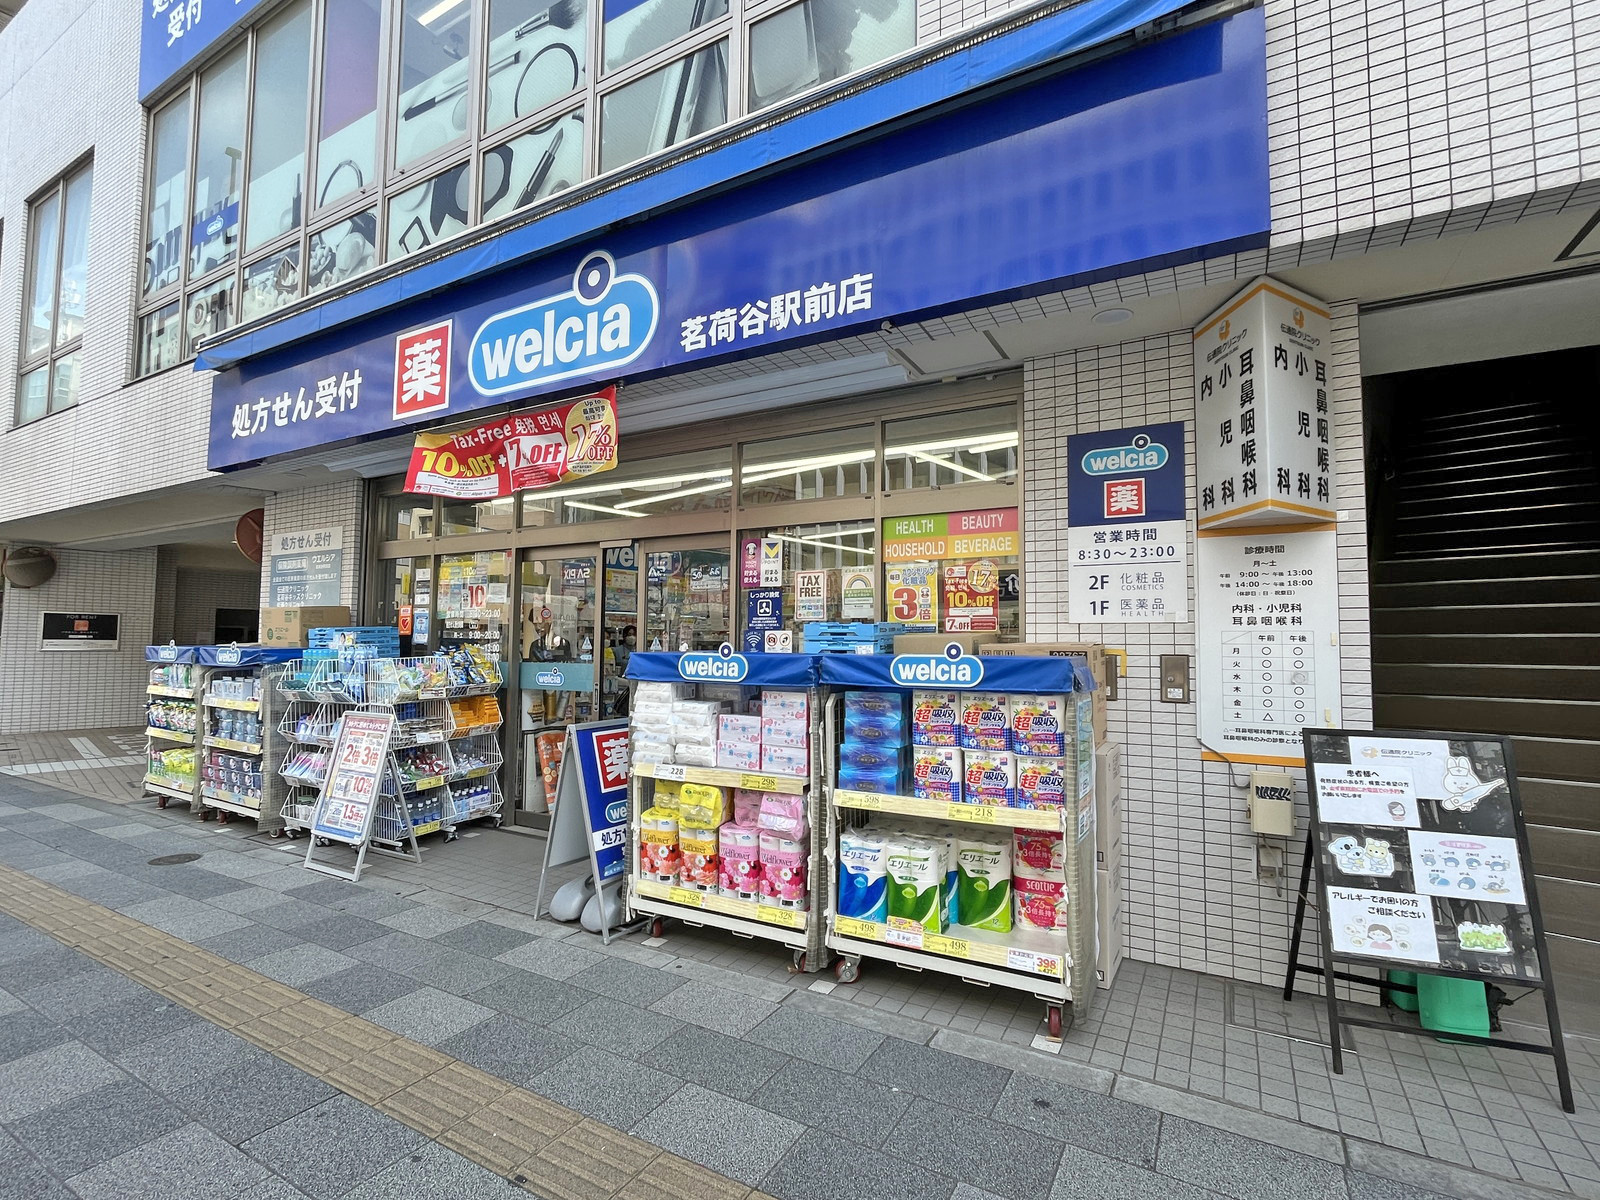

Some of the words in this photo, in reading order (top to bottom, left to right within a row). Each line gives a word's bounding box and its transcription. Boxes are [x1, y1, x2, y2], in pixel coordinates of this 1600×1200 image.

[167, 0, 203, 48] 受付
[679, 272, 874, 353] 茗荷谷駅前店
[481, 302, 630, 381] welcia
[401, 338, 443, 403] 薬
[231, 369, 363, 440] 処方せん受付
[1239, 347, 1258, 498] 耳鼻咽喉科
[451, 424, 512, 449] Tax-Free
[1314, 358, 1330, 503] 耳鼻咽喉科
[587, 445, 615, 461] OFF
[1090, 450, 1159, 471] welcia
[1109, 484, 1139, 513] 薬
[895, 519, 934, 535] HEALTH
[961, 513, 1004, 530] BEAUTY
[281, 532, 332, 551] 処方せん受付
[1093, 528, 1157, 544] 営業時間
[885, 541, 945, 558] HOUSEHOLD
[954, 536, 1012, 553] BEVERAGE
[1244, 545, 1285, 555] 診療時間
[1287, 569, 1313, 577] 13:00
[800, 575, 821, 587] TAX
[1089, 574, 1109, 590] 2F
[1120, 571, 1165, 584] 化粧品
[1287, 579, 1313, 587] 18:00
[799, 587, 822, 598] FREE
[1121, 583, 1164, 591] COSMETICS
[1089, 600, 1109, 616] 1F
[1120, 597, 1165, 610] 医薬品
[1232, 616, 1303, 626] 耳鼻咽喉科
[1258, 634, 1275, 642] 午前
[1289, 634, 1307, 643] 午後
[1232, 647, 1240, 655] 月
[684, 657, 740, 678] welcia
[1232, 660, 1241, 668] 火
[897, 660, 971, 681] welcia
[538, 674, 561, 684] welcia
[1233, 711, 1242, 719] 土
[670, 767, 684, 776] 228
[761, 777, 776, 786] 298
[864, 795, 880, 804] 598
[974, 807, 993, 818] 218
[843, 850, 879, 862] エリエール
[961, 853, 1000, 865] エリエール
[889, 859, 928, 871] エリエール
[1026, 879, 1055, 893] scottie
[687, 892, 700, 901] 328
[1331, 891, 1419, 908] アレルギーでお困りの方
[778, 911, 793, 921] 328
[1367, 906, 1427, 919] ご相談ください
[859, 922, 876, 933] 498
[949, 941, 968, 951] 498
[1036, 957, 1057, 970] 398
